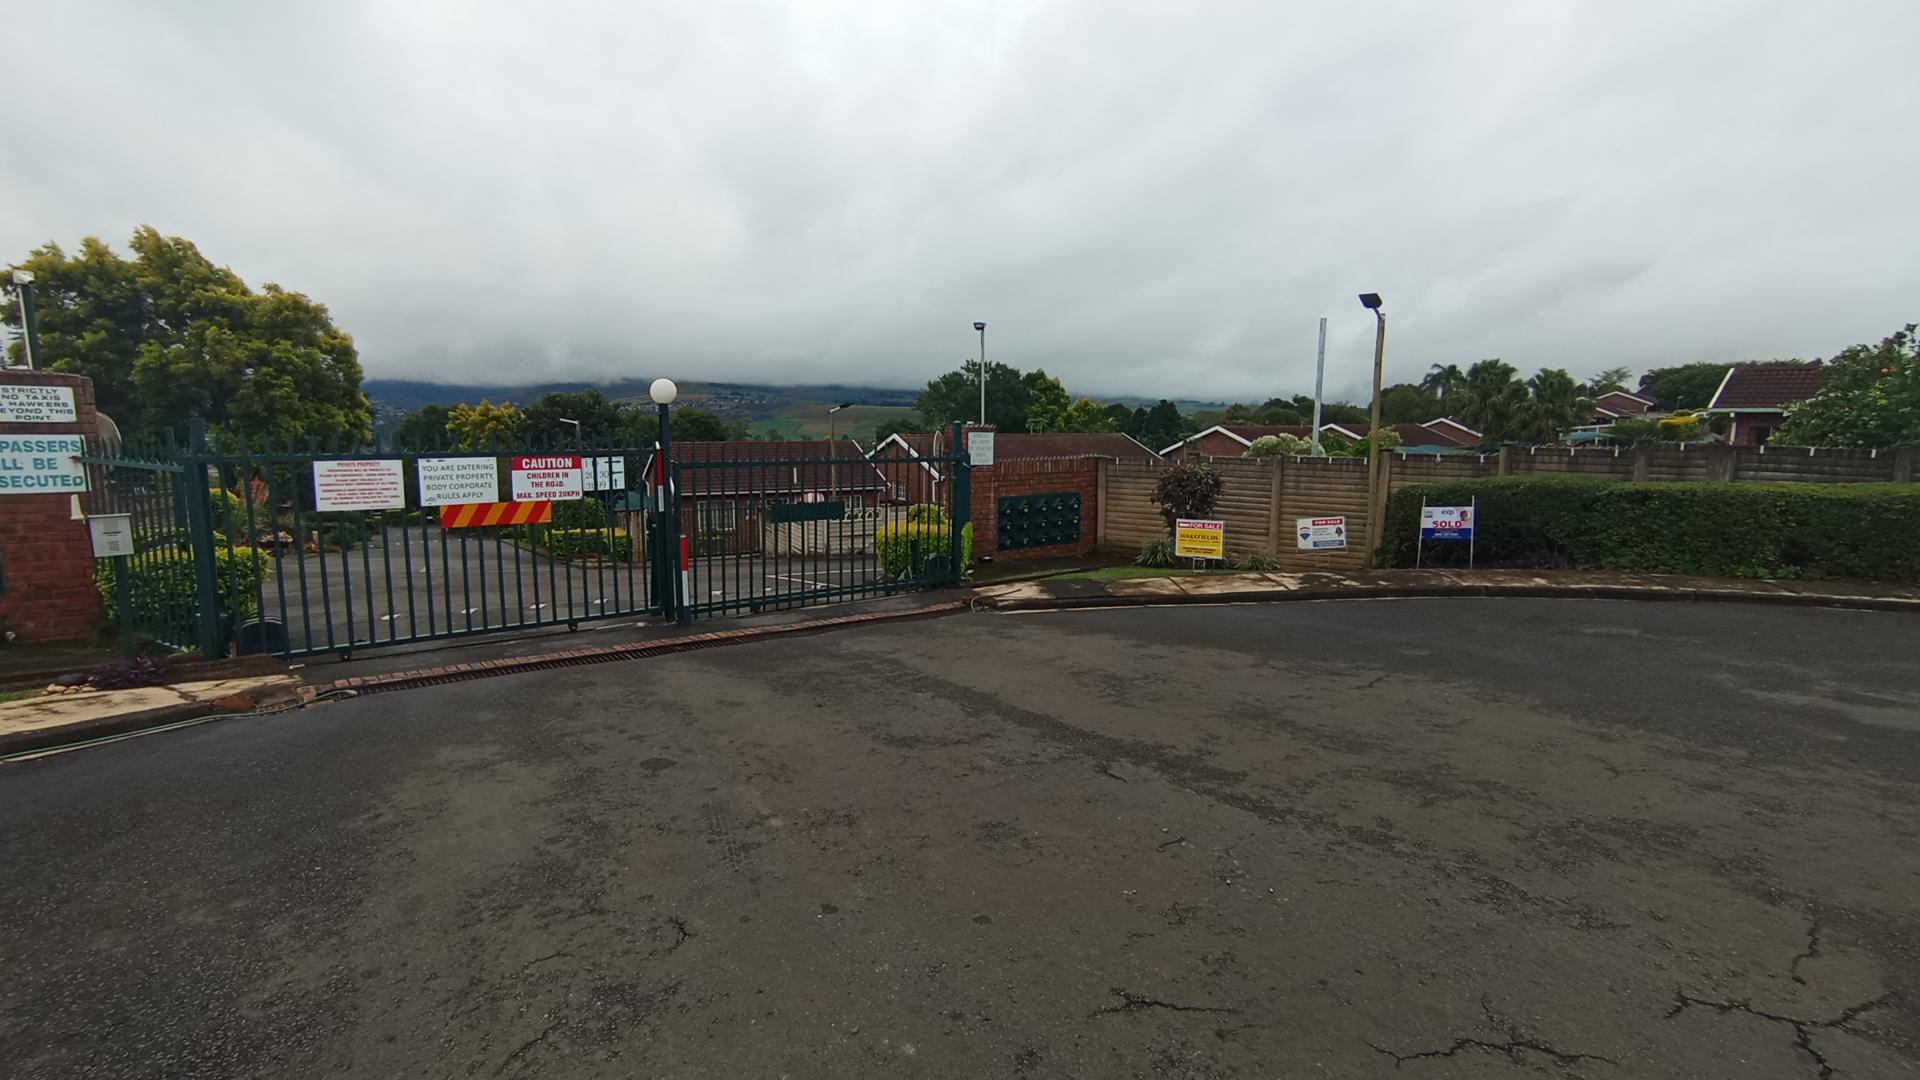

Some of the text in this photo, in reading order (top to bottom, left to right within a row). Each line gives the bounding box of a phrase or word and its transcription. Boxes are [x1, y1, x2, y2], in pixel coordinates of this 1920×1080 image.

[33, 457, 58, 470] BE
[522, 458, 573, 469] CAUTION
[440, 464, 454, 472] ARE
[449, 482, 493, 490] CORPORATE
[1432, 520, 1463, 528] SOLD
